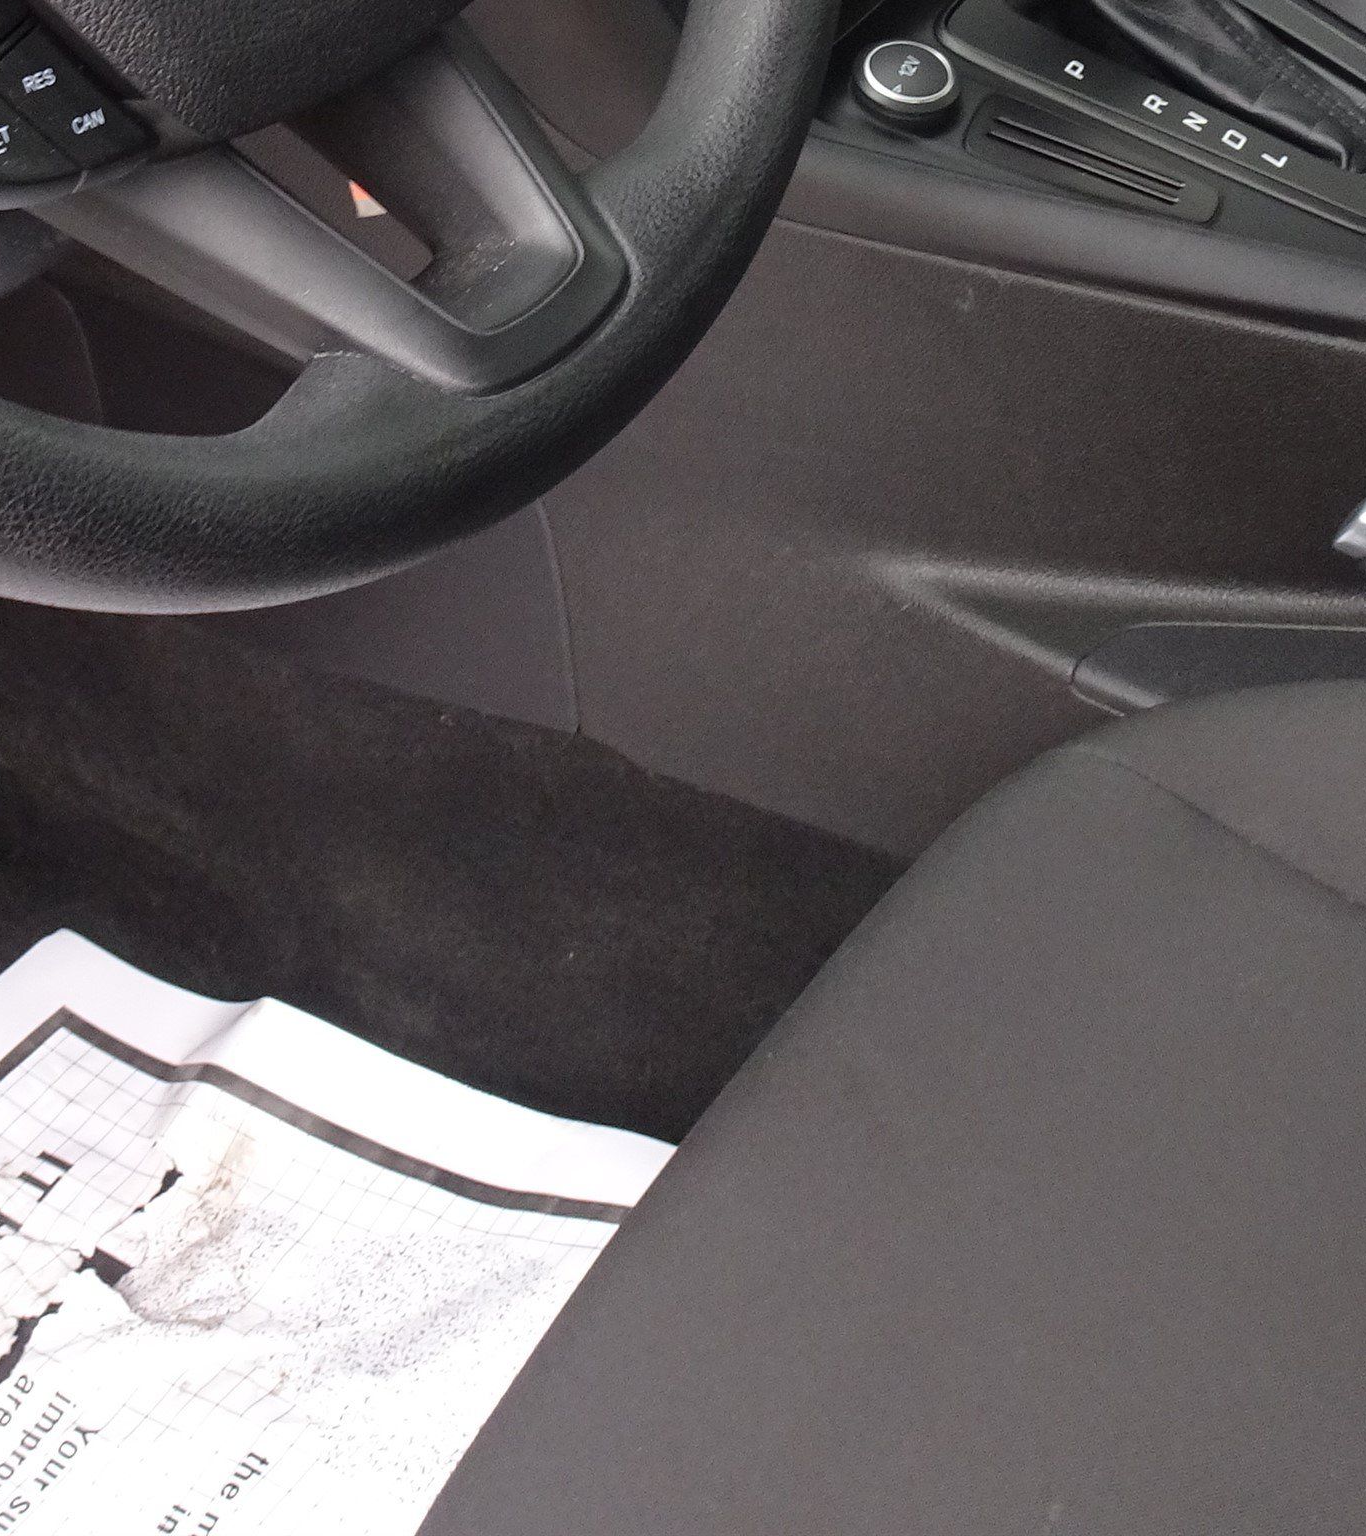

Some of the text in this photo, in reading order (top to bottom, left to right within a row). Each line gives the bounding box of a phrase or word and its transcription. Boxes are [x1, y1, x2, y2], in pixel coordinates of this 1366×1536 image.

[21, 68, 57, 94] RES
[71, 108, 106, 135] CAN
[1064, 60, 1288, 169] P R N D L
[17, 1150, 75, 1203] IT
[34, 1425, 102, 1492] Your
[220, 1451, 270, 1500] the
